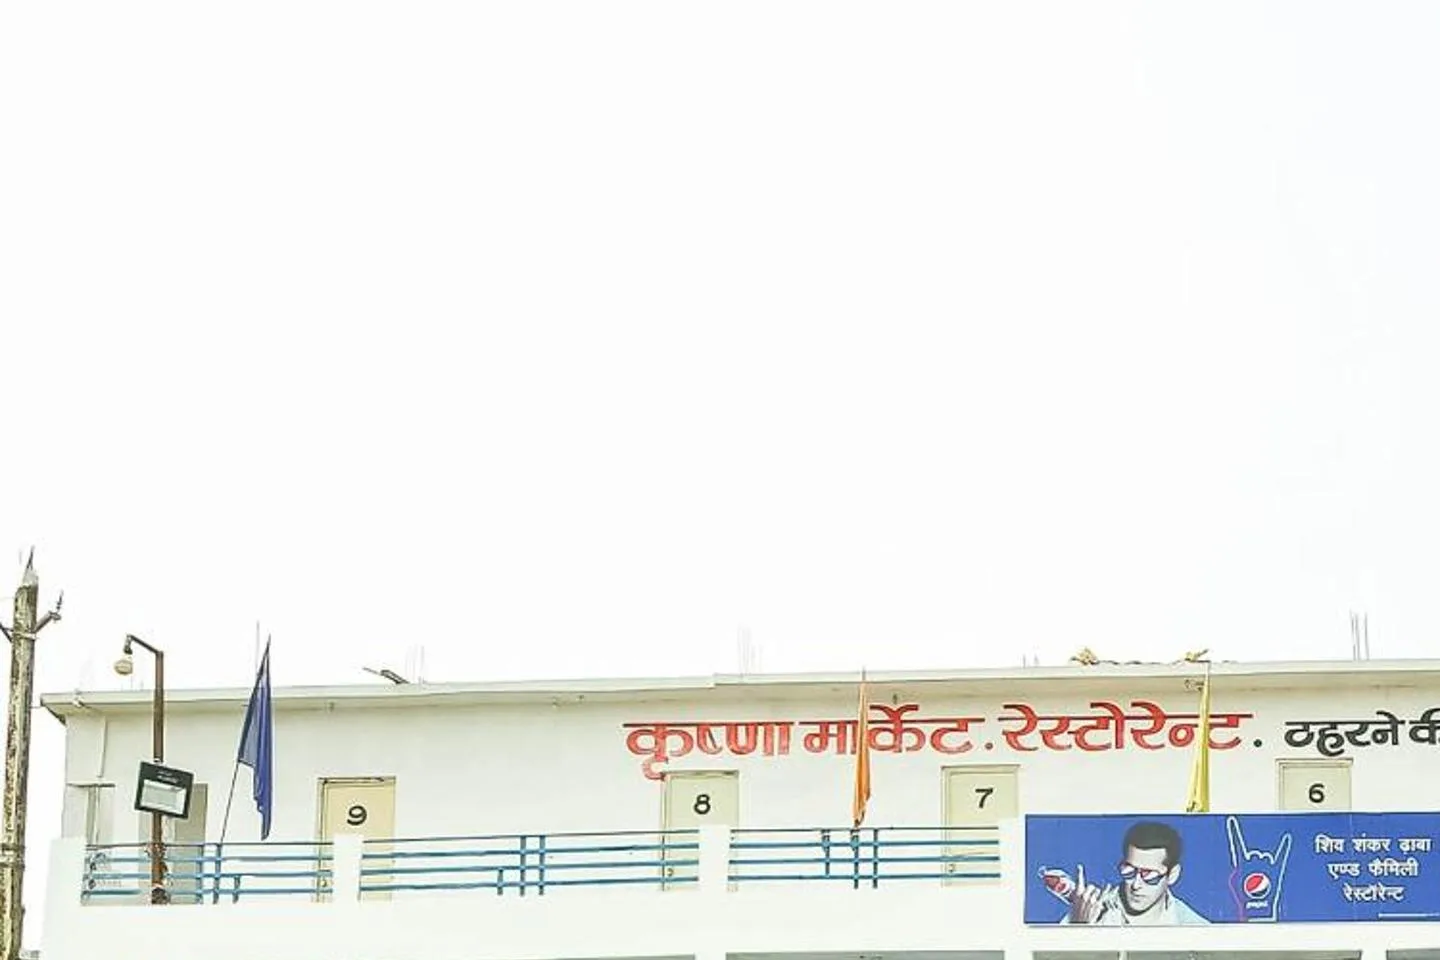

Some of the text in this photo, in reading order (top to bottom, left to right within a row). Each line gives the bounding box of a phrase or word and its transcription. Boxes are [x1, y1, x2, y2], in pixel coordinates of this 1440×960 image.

[623, 720, 794, 781] कृष्णा
[1284, 710, 1405, 758] ठहरने
[693, 793, 712, 816] 8
[975, 787, 994, 809] 7
[1308, 783, 1326, 804] 6
[345, 805, 368, 826] 9
[1314, 833, 1345, 854] शिव
[1351, 832, 1392, 853] शंकर
